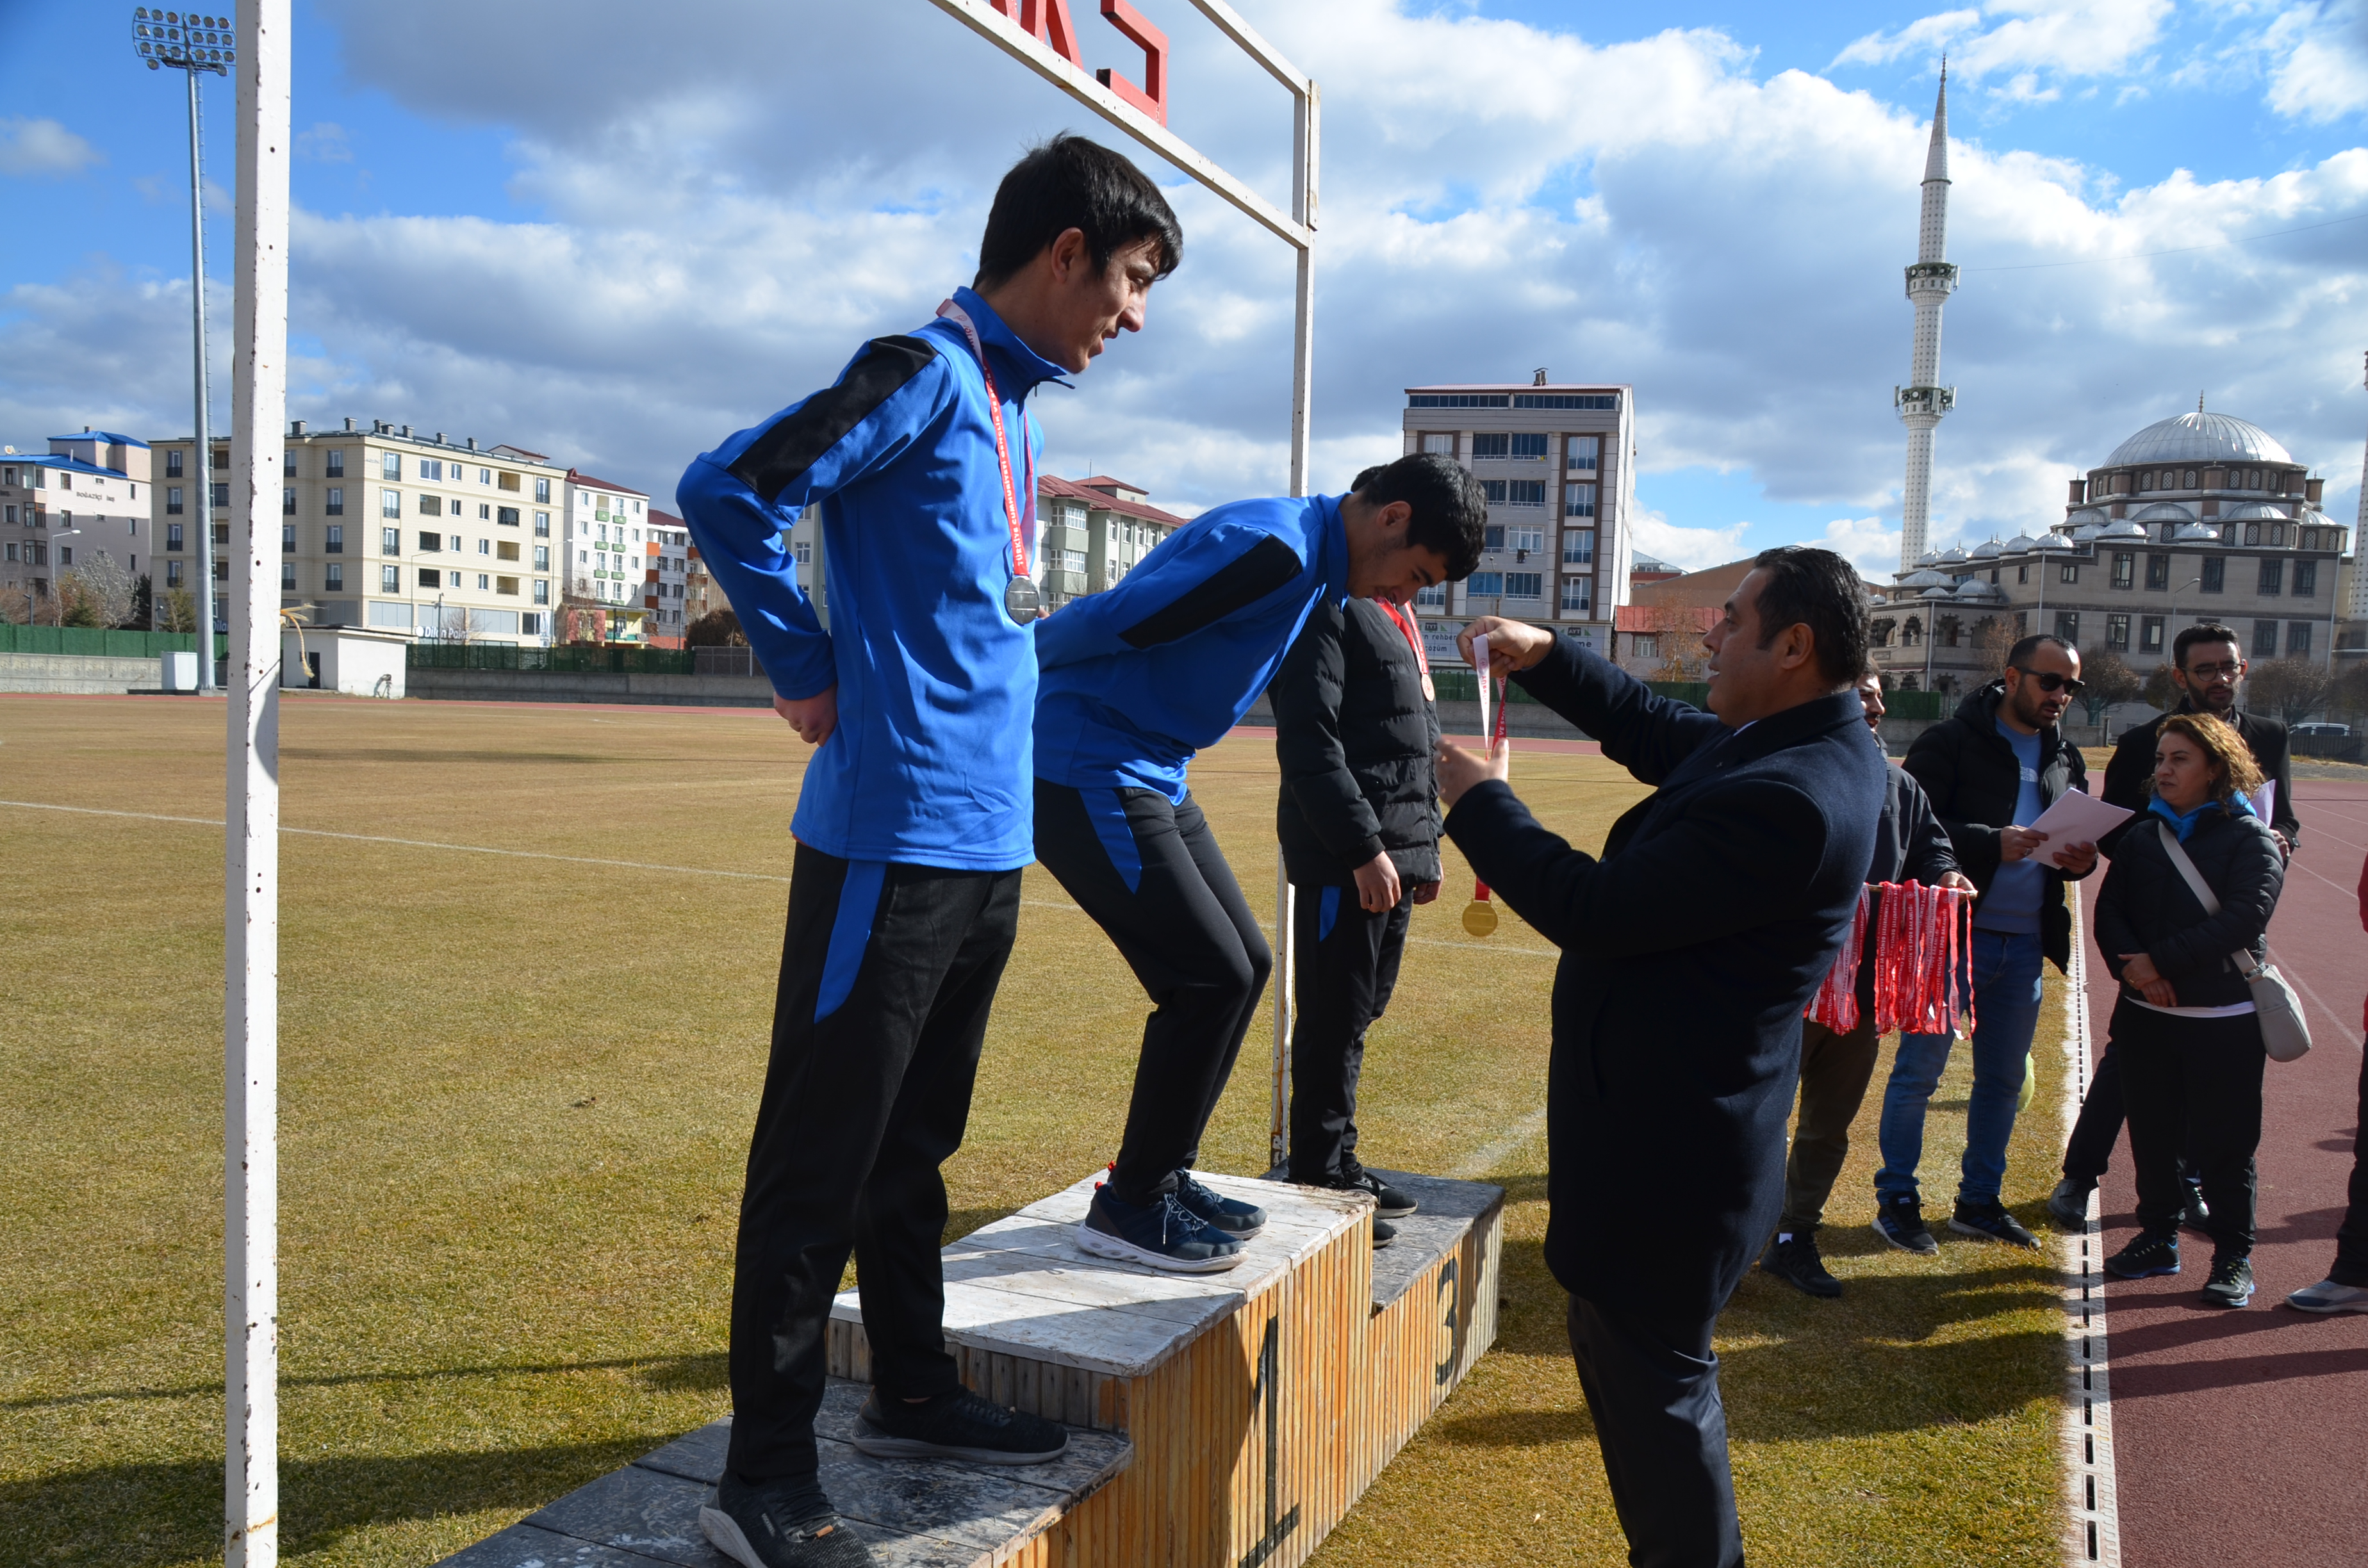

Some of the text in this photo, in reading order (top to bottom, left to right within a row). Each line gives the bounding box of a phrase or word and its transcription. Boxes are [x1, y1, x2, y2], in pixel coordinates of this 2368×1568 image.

[992, 400, 998, 413] VE
[76, 491, 103, 501] BOĞAZİÇİ
[1001, 461, 1017, 525] CUMHURİYETİ
[1012, 527, 1024, 566] TÜRKİYE
[1499, 726, 1504, 735] VE
[1436, 1255, 1458, 1385] 3
[1238, 1314, 1299, 1568] 1
